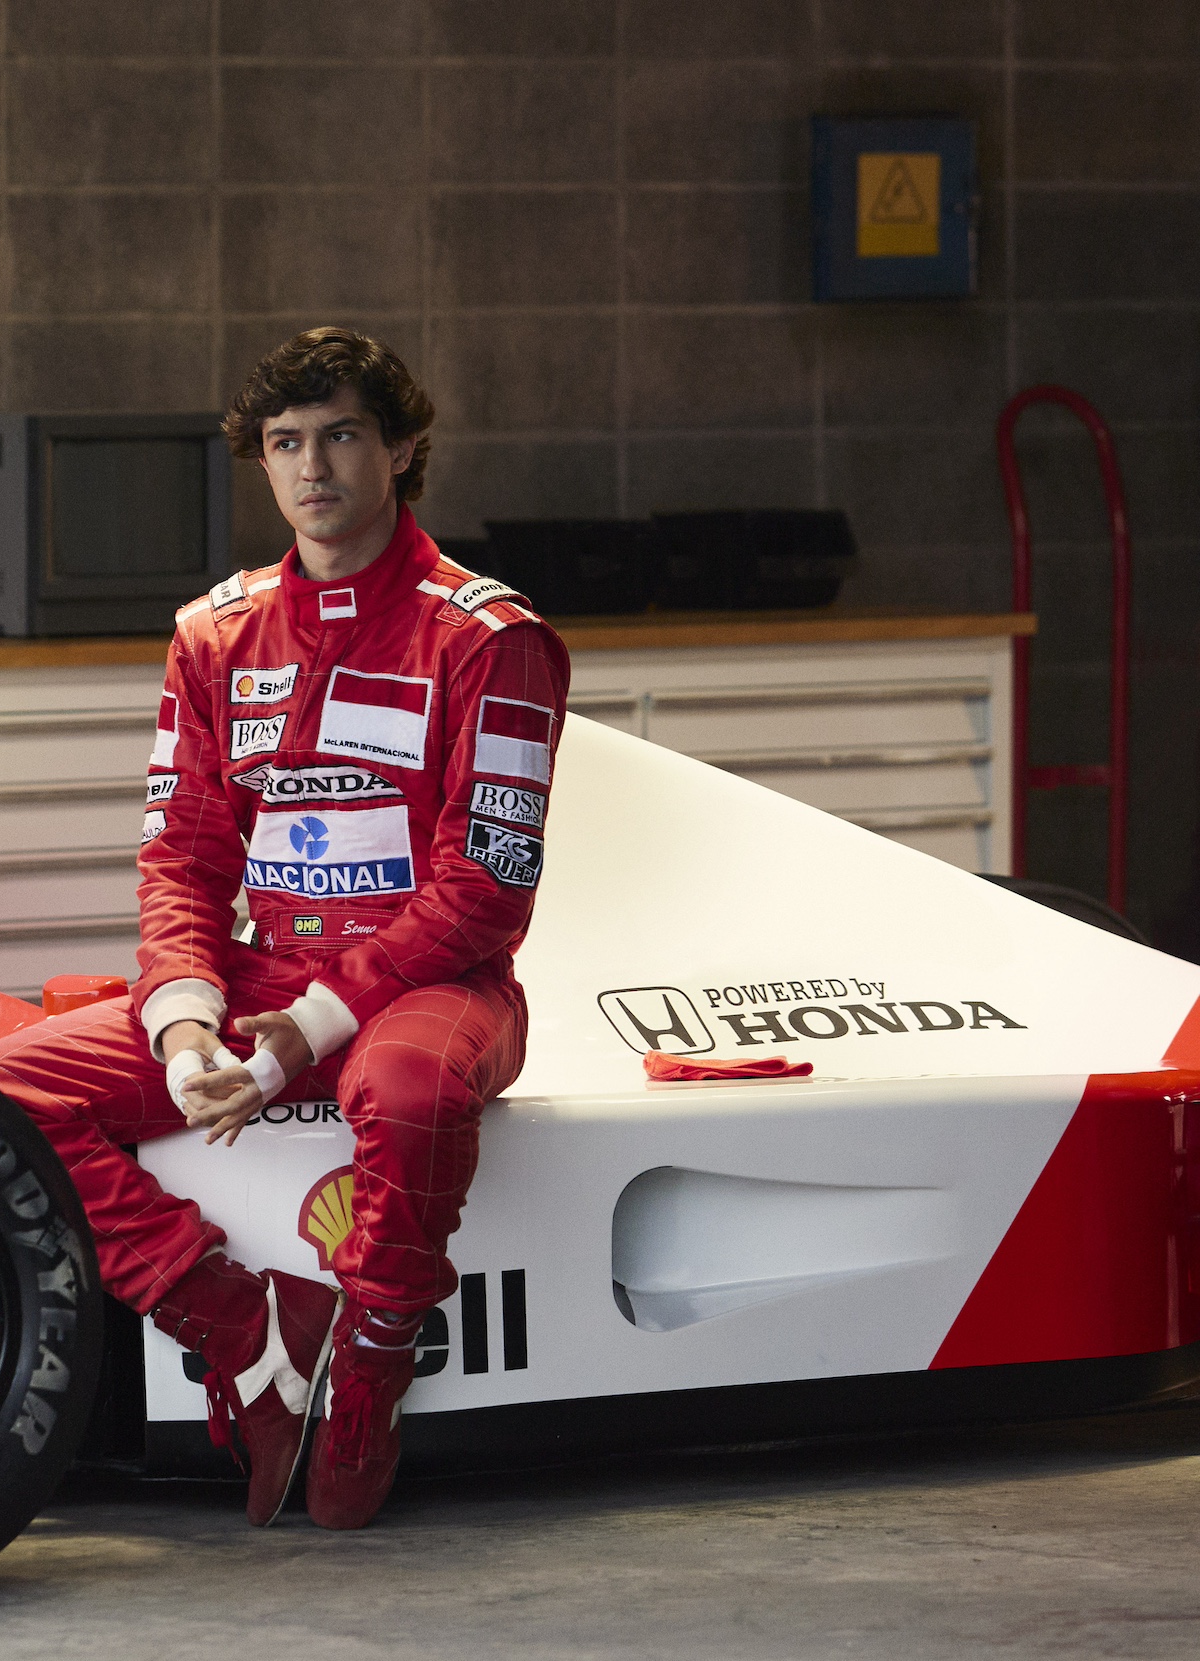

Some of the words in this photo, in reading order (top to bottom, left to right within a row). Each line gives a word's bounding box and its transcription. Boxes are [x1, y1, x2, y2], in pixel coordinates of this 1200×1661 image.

[463, 583, 507, 603] GOOD
[258, 677, 291, 695] Shell
[236, 717, 282, 747] BOSS
[324, 738, 359, 749] McLAREN
[360, 743, 420, 761] INTERNACIONAL
[148, 780, 174, 796] ell
[479, 785, 541, 817] BOSS
[246, 860, 394, 894] NACIONAL
[473, 849, 533, 882] HEUER
[703, 977, 849, 1008] POWERED
[849, 977, 885, 999] by
[716, 1000, 1029, 1047] HONDA
[245, 1104, 343, 1125] OUR
